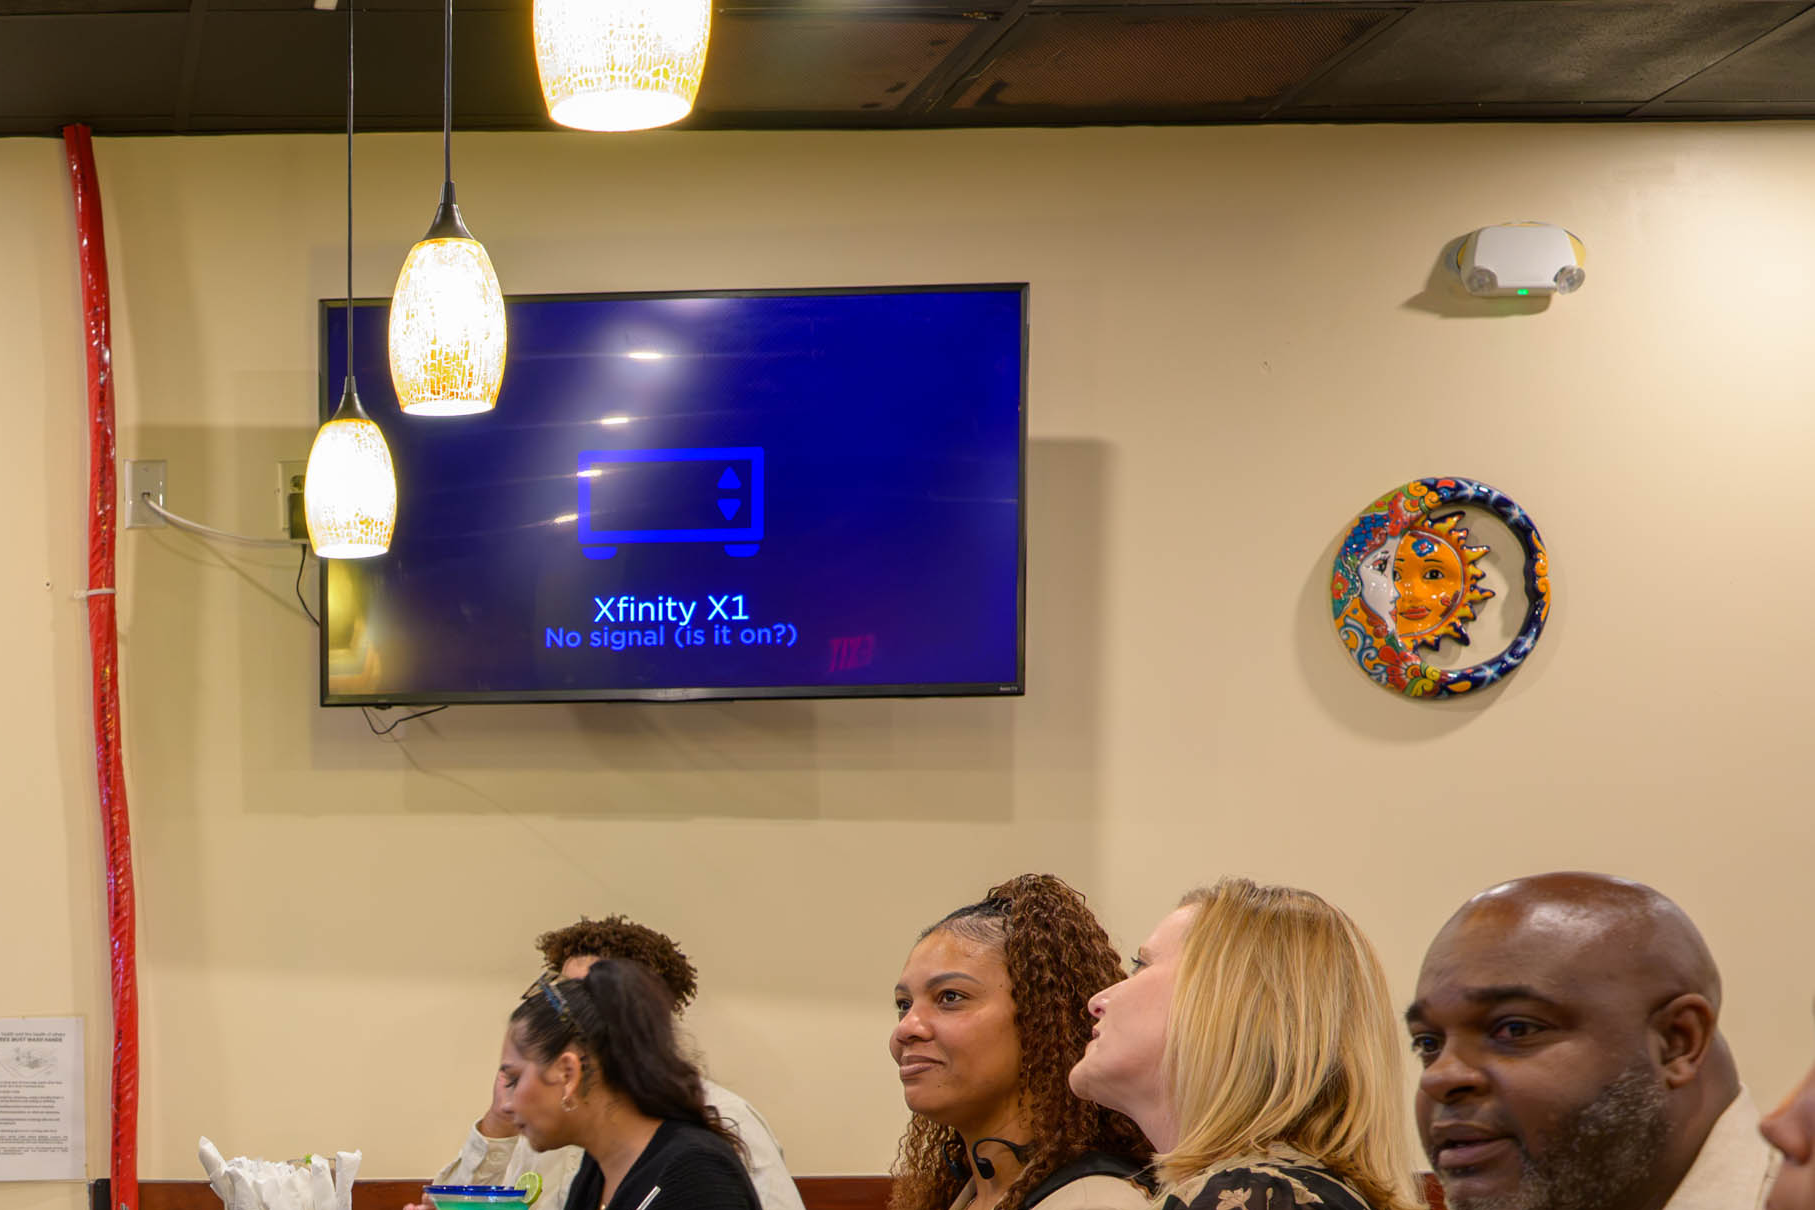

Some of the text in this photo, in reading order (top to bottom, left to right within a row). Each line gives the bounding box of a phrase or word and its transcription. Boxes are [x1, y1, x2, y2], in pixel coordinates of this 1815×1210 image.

[593, 594, 749, 626] Xfinity X1
[545, 623, 798, 651] No signal (is it on?)
